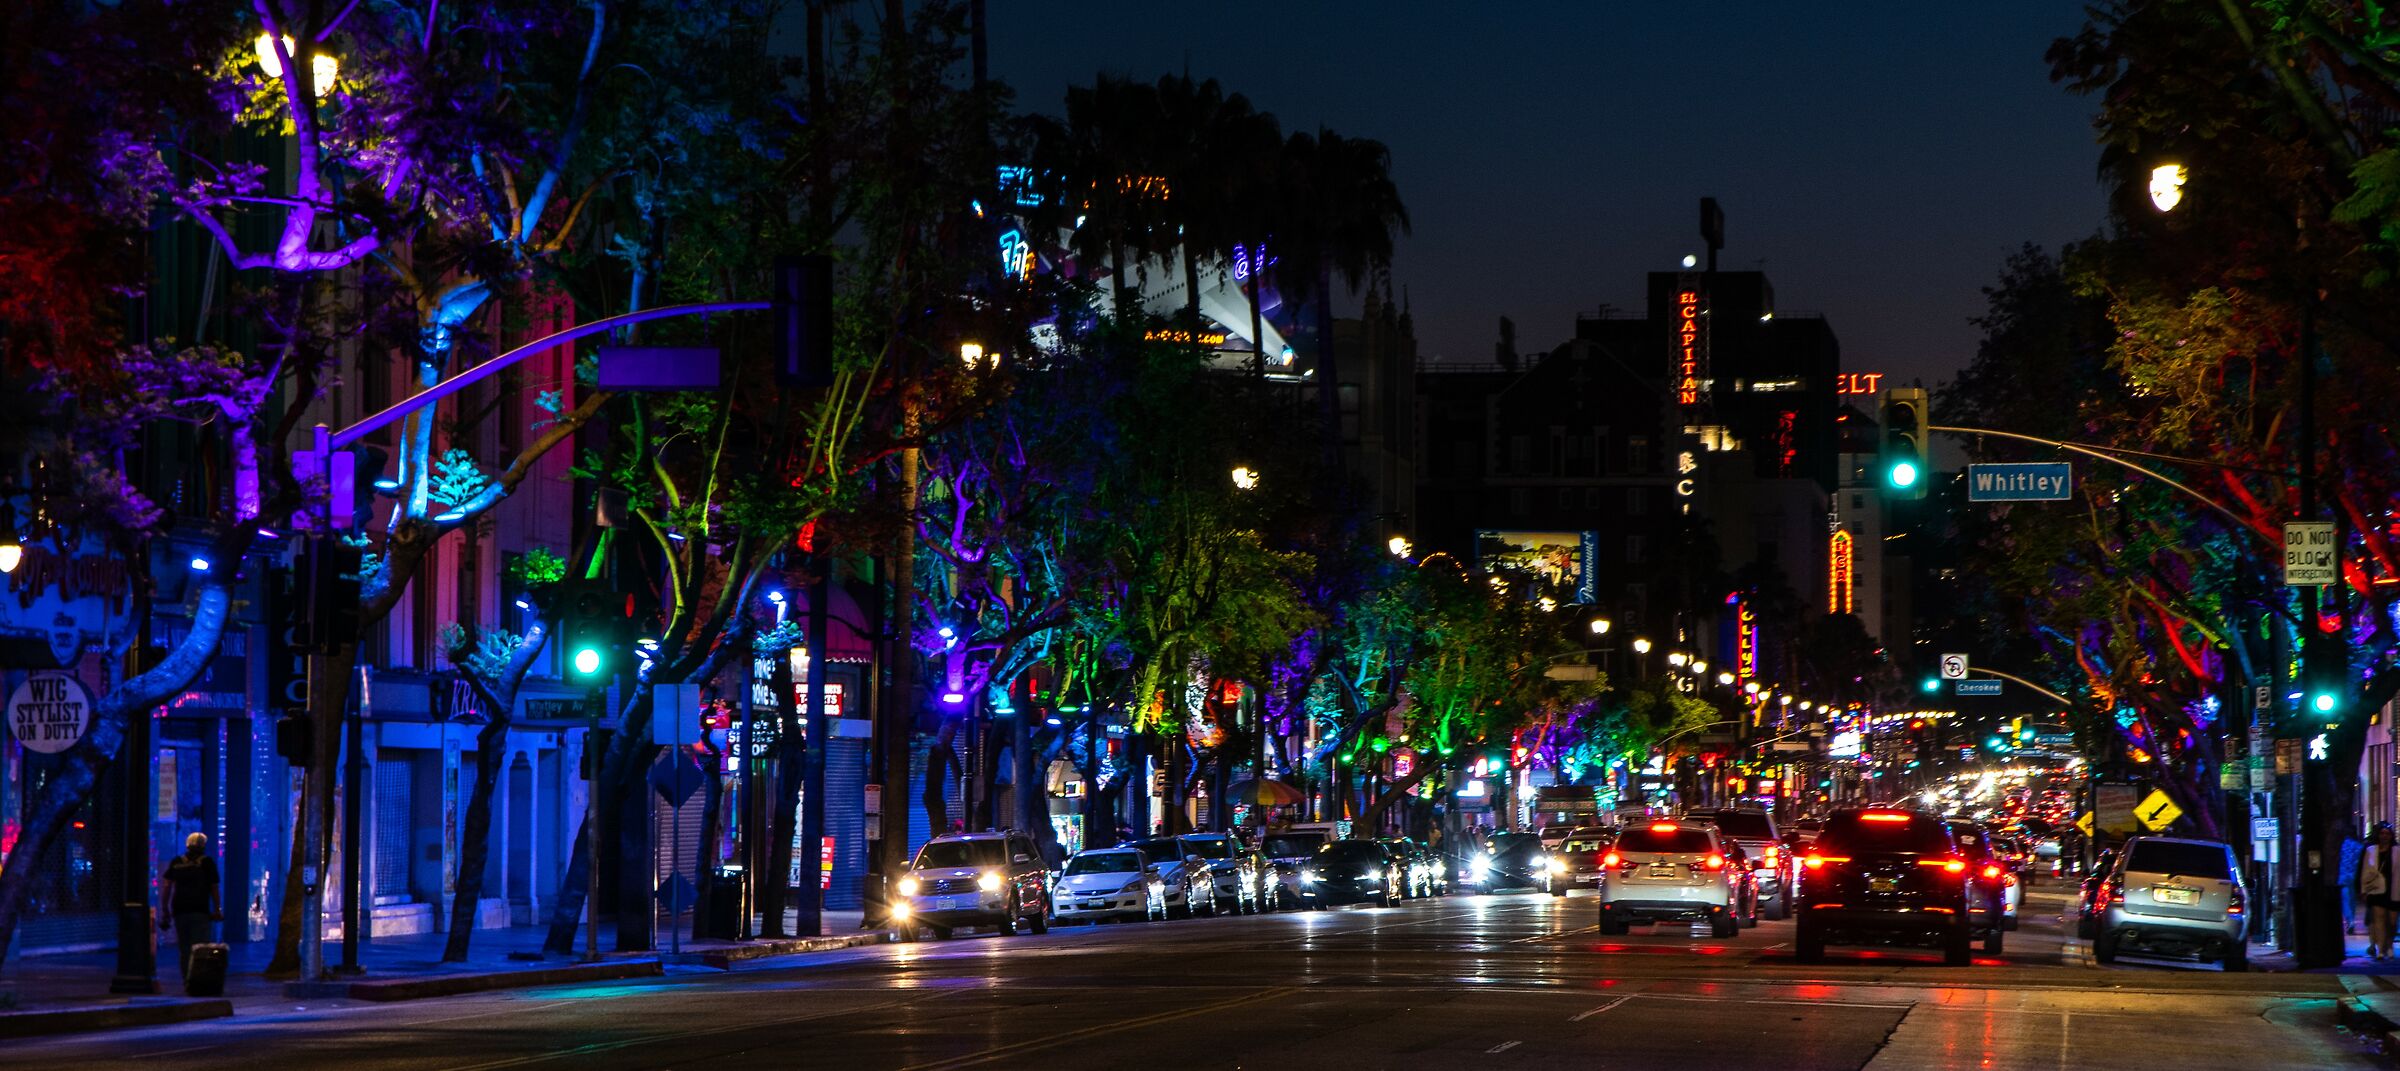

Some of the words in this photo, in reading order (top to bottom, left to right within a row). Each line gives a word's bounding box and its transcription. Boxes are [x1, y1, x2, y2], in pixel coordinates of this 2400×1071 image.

[1680, 292, 1698, 305] EL
[1680, 305, 1697, 404] CAPITAN
[1977, 472, 2064, 495] Whitley
[2287, 531, 2303, 545] DO
[2309, 531, 2332, 545] NOT
[2287, 551, 2333, 566] BLOCK
[29, 678, 67, 702] WIG
[1958, 683, 2000, 692] Cherokee
[16, 702, 82, 723] STYLIST
[18, 724, 36, 741] ON
[43, 723, 79, 740] DUTY
